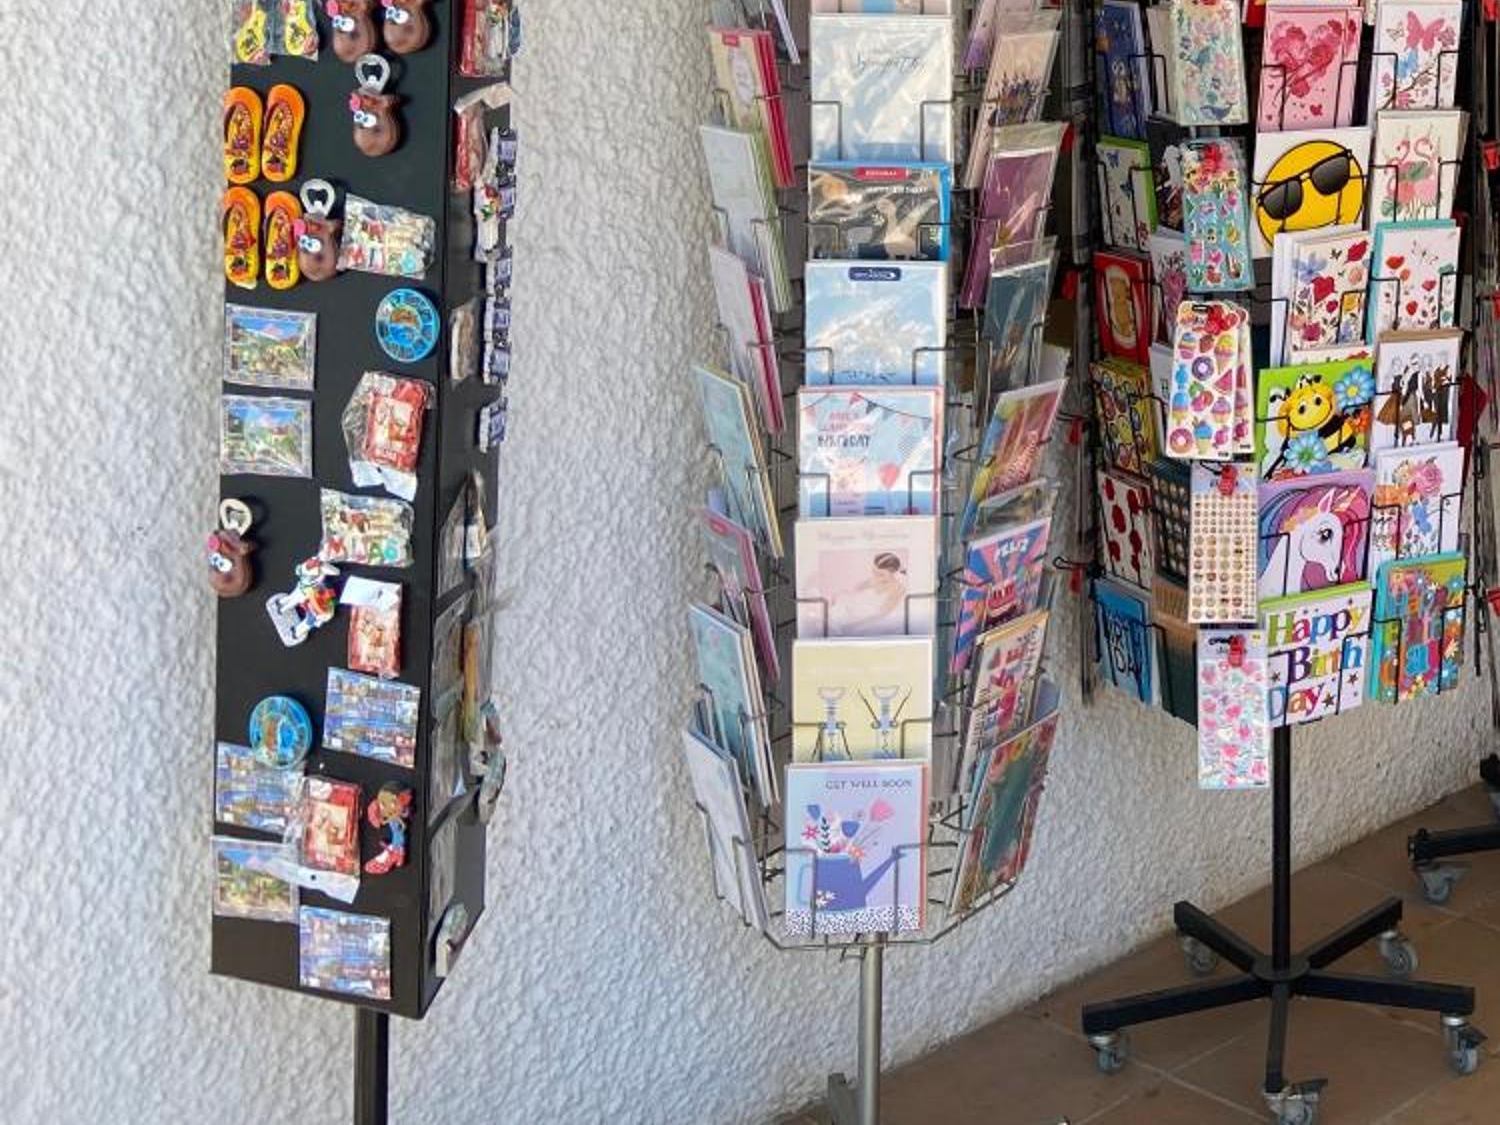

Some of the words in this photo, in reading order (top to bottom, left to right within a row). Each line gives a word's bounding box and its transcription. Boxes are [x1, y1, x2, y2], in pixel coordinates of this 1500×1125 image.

[1268, 605, 1363, 647] Happy
[1287, 636, 1362, 684] Birth
[1267, 683, 1326, 722] Day
[825, 778, 848, 790] GET
[850, 778, 879, 789] WELL
[881, 778, 913, 788] SOON
